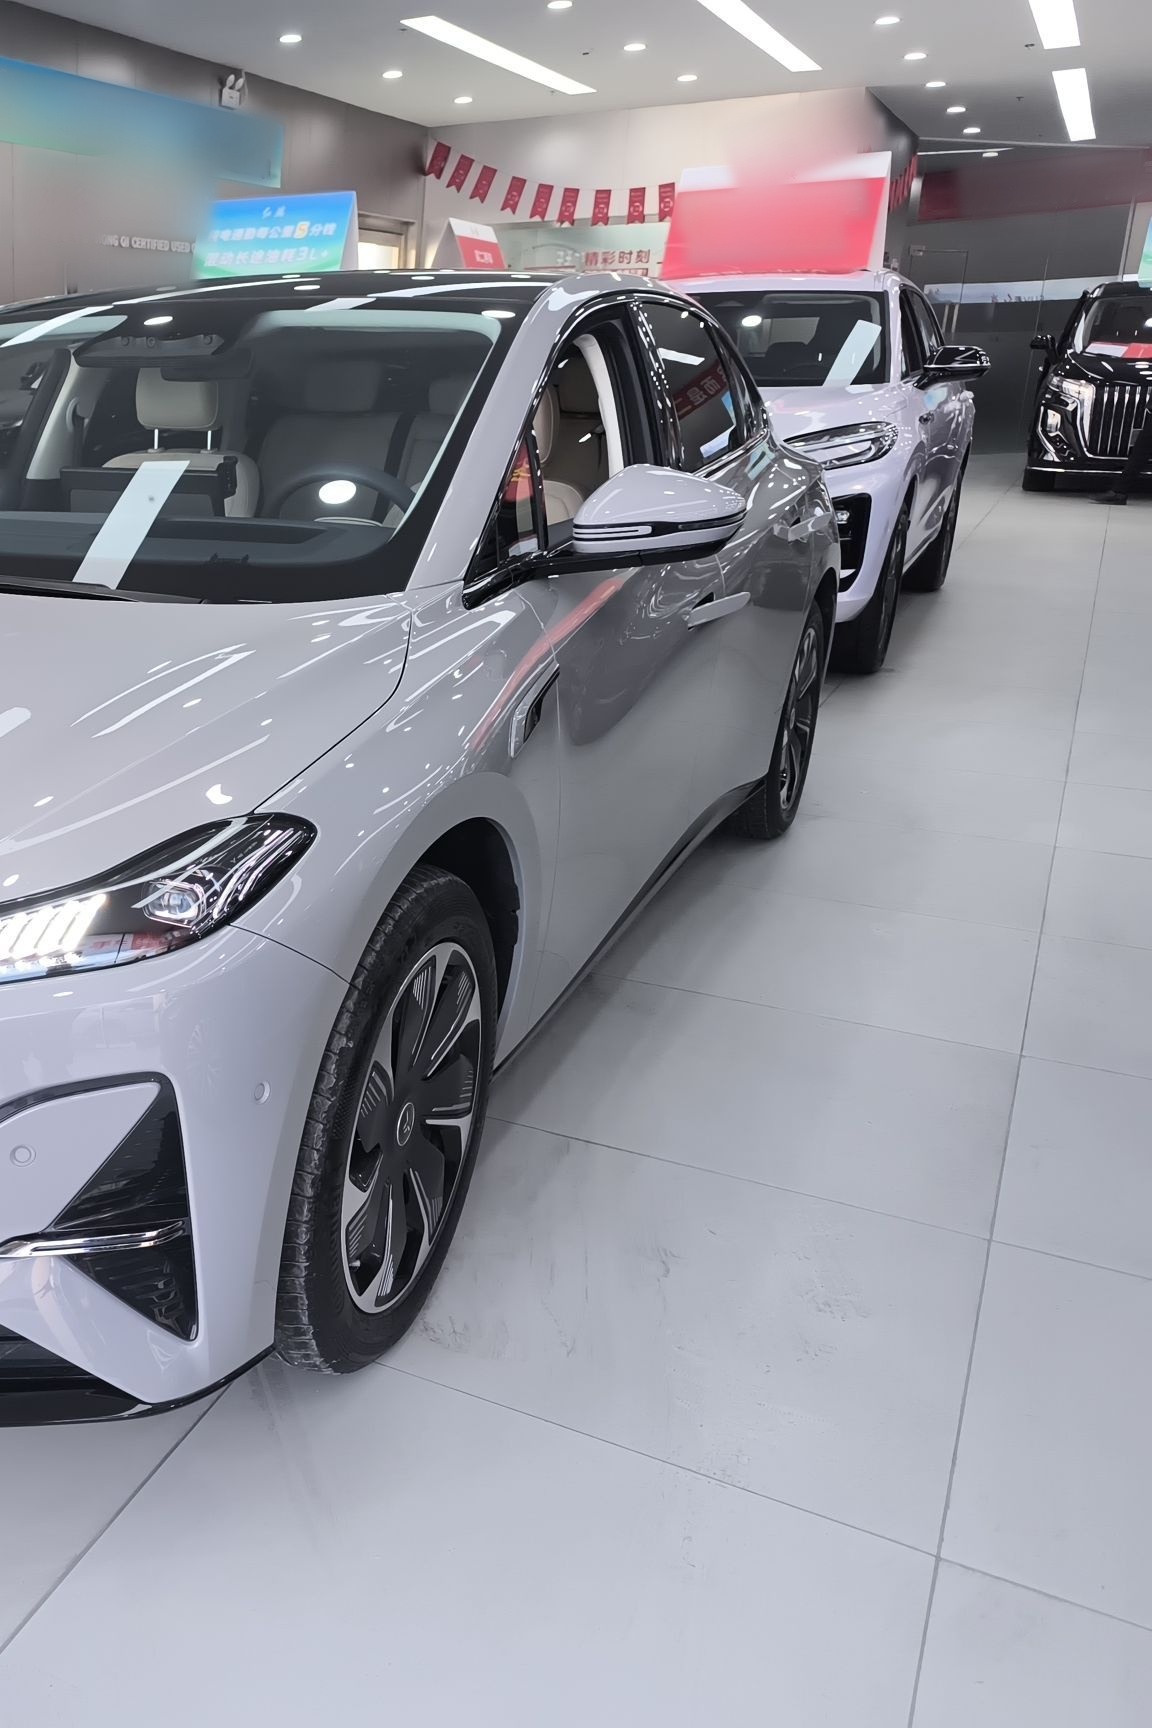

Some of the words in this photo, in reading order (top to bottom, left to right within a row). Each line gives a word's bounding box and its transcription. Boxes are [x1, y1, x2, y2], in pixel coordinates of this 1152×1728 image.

[131, 236, 170, 251] CERTIFIED
[171, 240, 191, 253] USED
[584, 248, 650, 266] 精彩时刻
